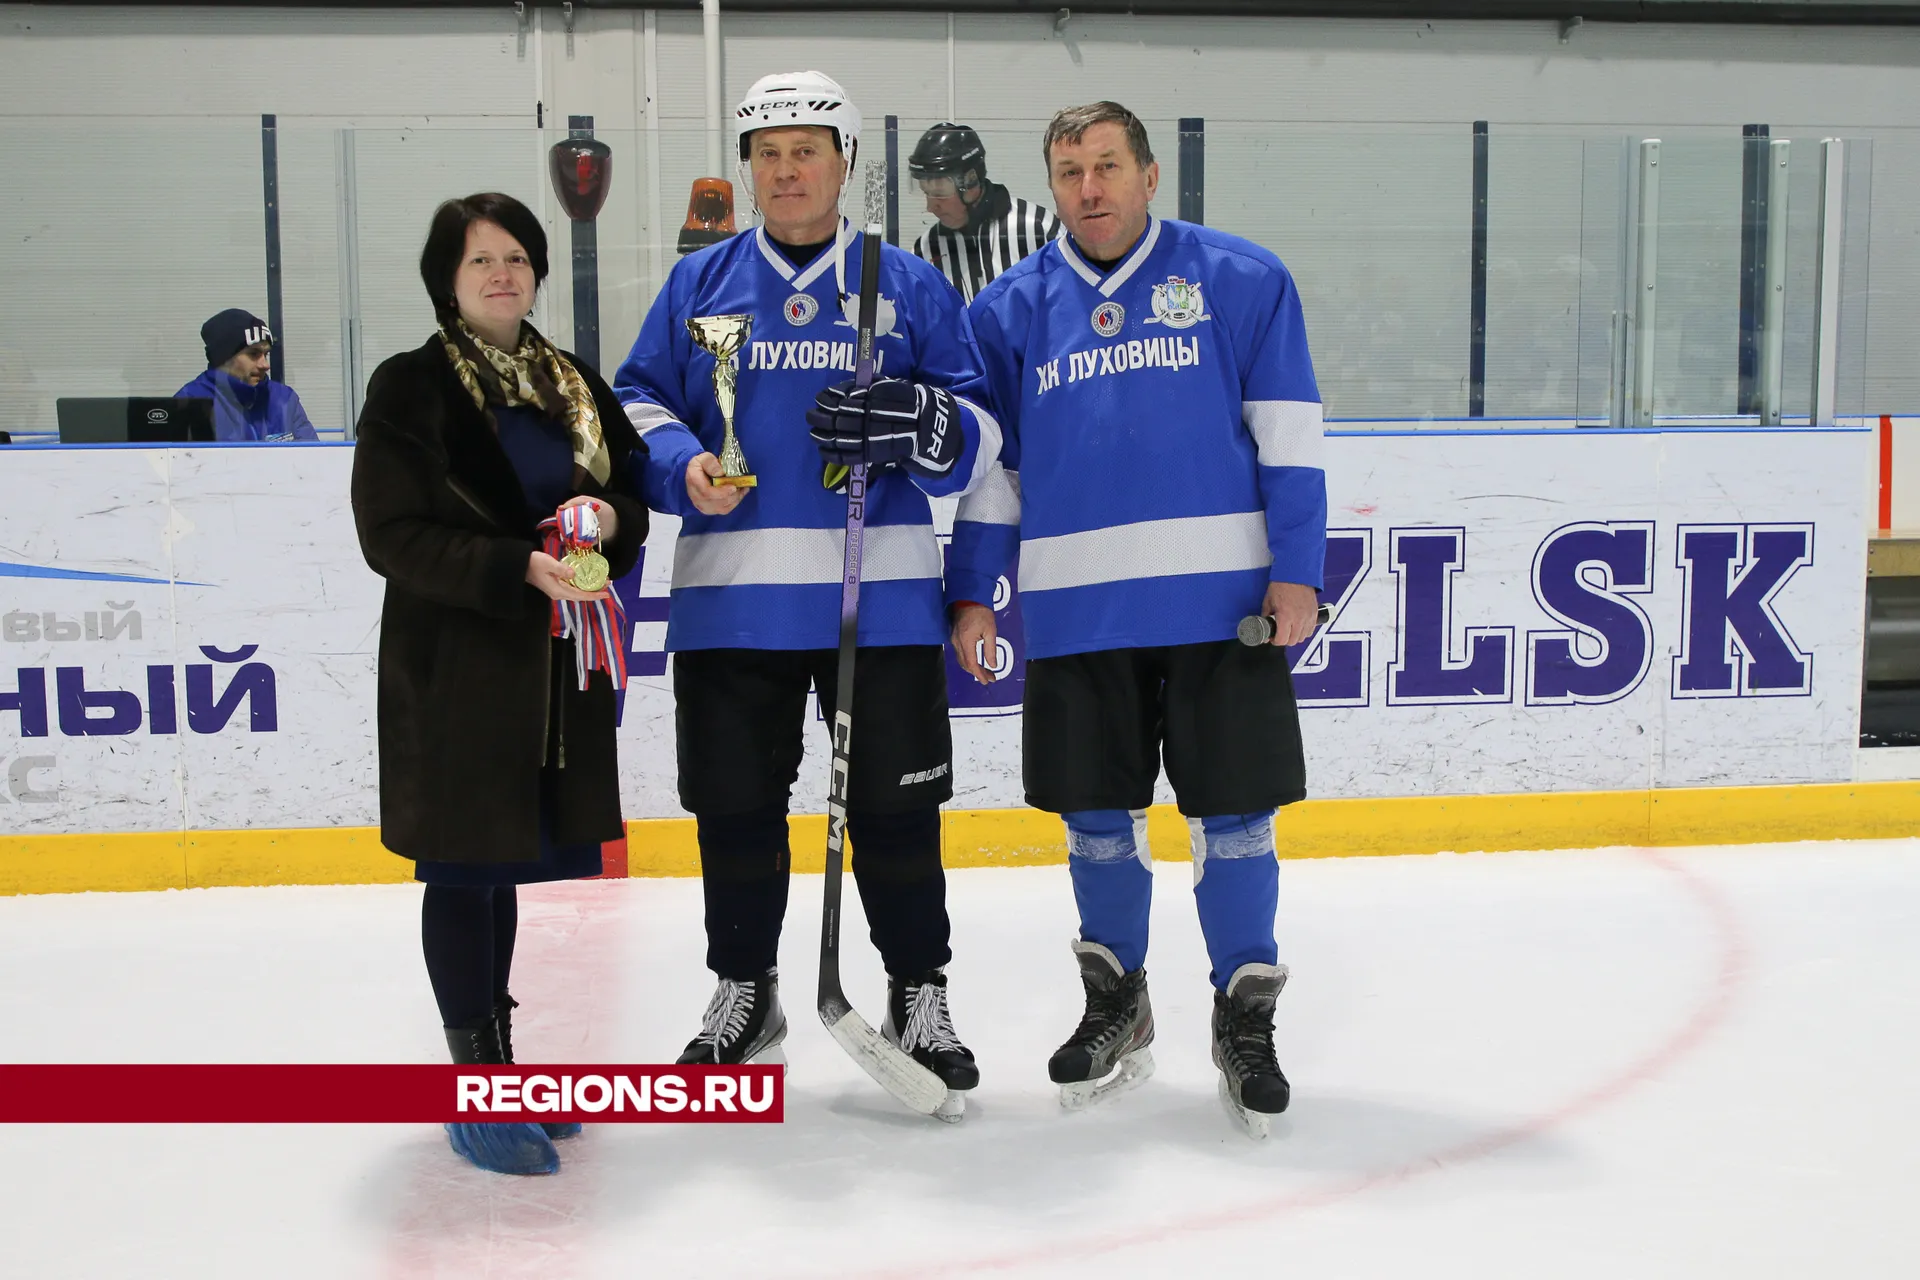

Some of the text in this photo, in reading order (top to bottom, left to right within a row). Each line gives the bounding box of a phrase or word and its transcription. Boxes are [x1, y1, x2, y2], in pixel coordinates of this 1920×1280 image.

[759, 101, 799, 110] CCM
[1036, 336, 1199, 395] ХК ЛУХОВИЦЫ
[850, 528, 860, 575] TRIGGER
[849, 576, 857, 584] 8
[828, 710, 852, 853] CCM
